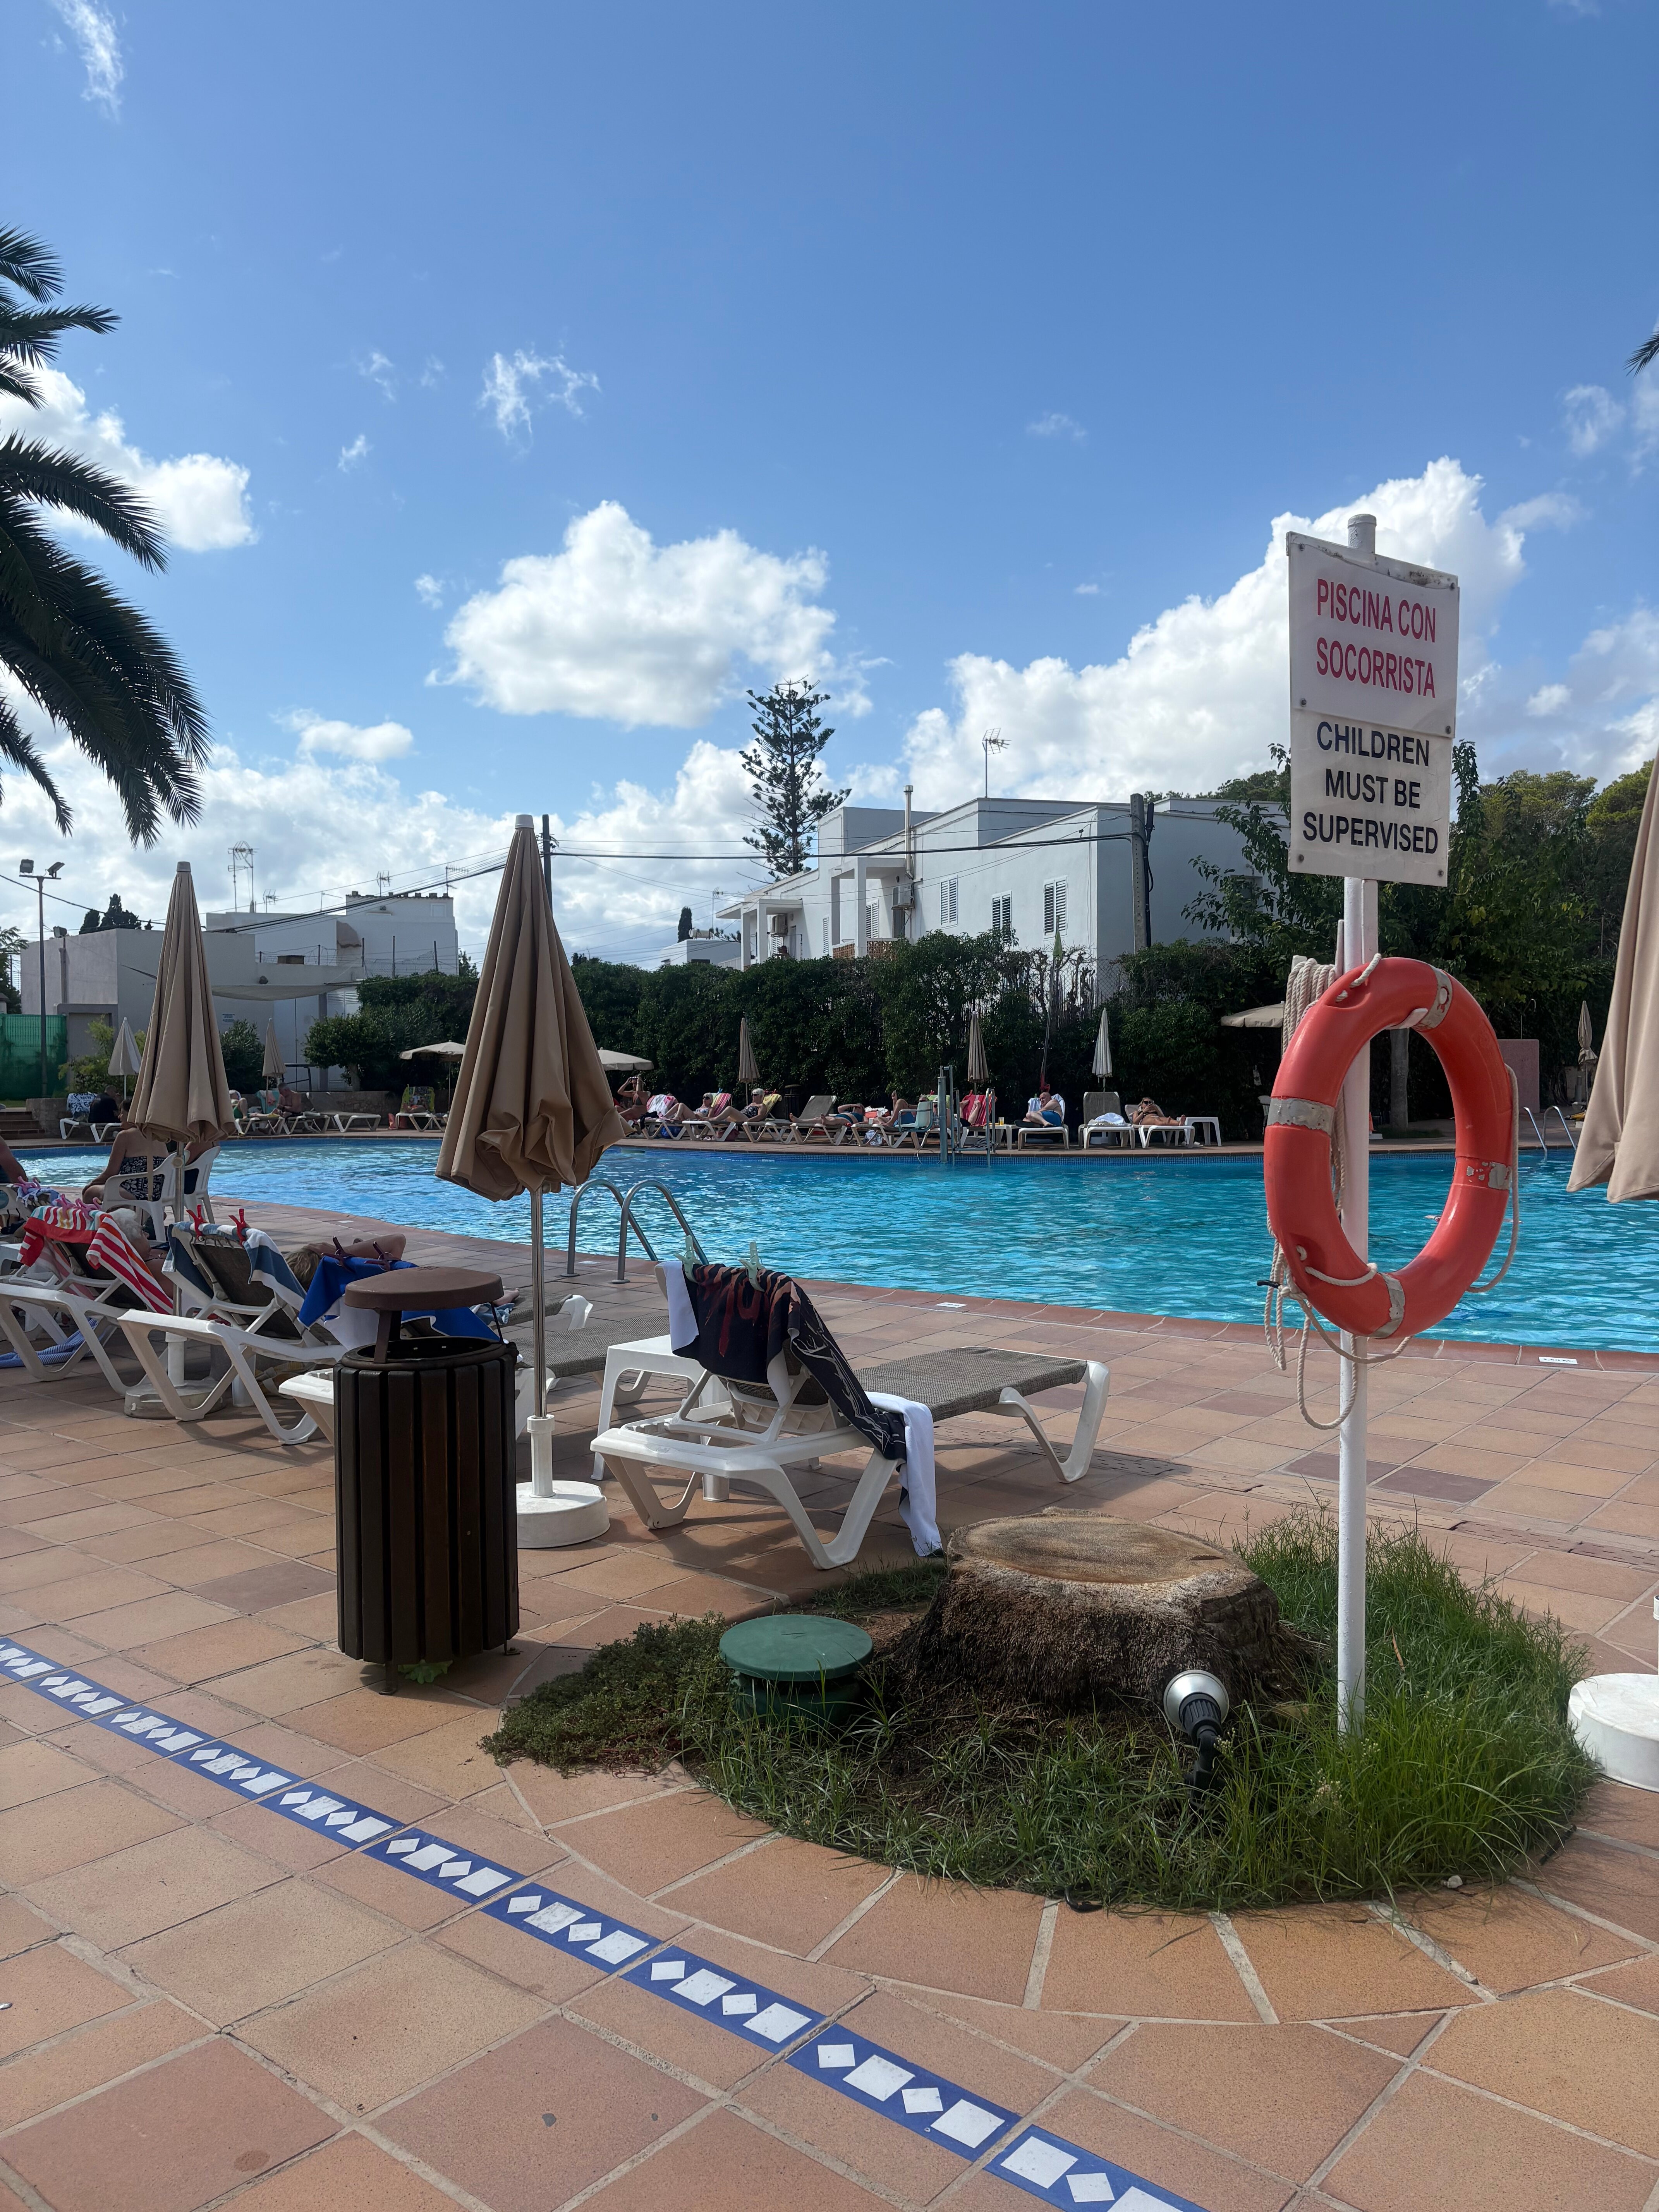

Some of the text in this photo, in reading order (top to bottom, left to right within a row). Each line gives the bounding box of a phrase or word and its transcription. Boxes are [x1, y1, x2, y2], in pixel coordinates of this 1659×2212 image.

[1317, 578, 1436, 643] PISCINA CON
[1316, 637, 1436, 698] SOCORRISTA
[1317, 721, 1429, 767] CHILDREN
[1326, 768, 1421, 809] MUST BE
[1303, 812, 1438, 854] SUPERVISED
